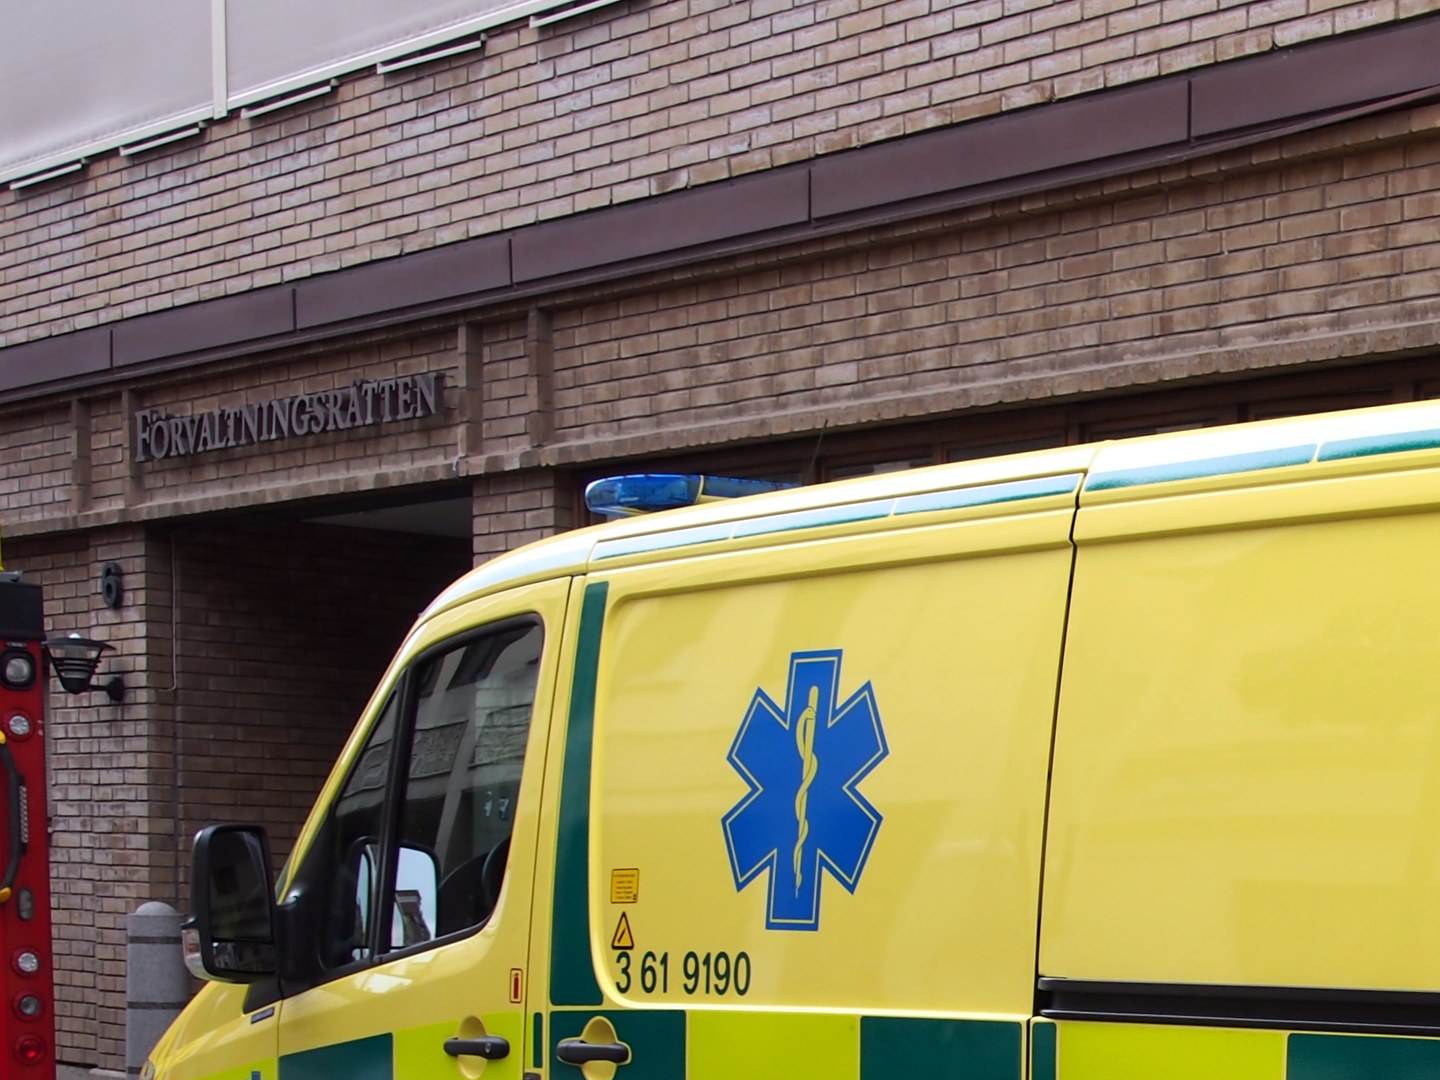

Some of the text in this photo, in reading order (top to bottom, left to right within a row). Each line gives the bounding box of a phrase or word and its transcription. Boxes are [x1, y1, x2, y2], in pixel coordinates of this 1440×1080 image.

[134, 373, 445, 462] FÖRVALTNINGSRÄTTEN
[615, 951, 751, 996] 3 61 9190
